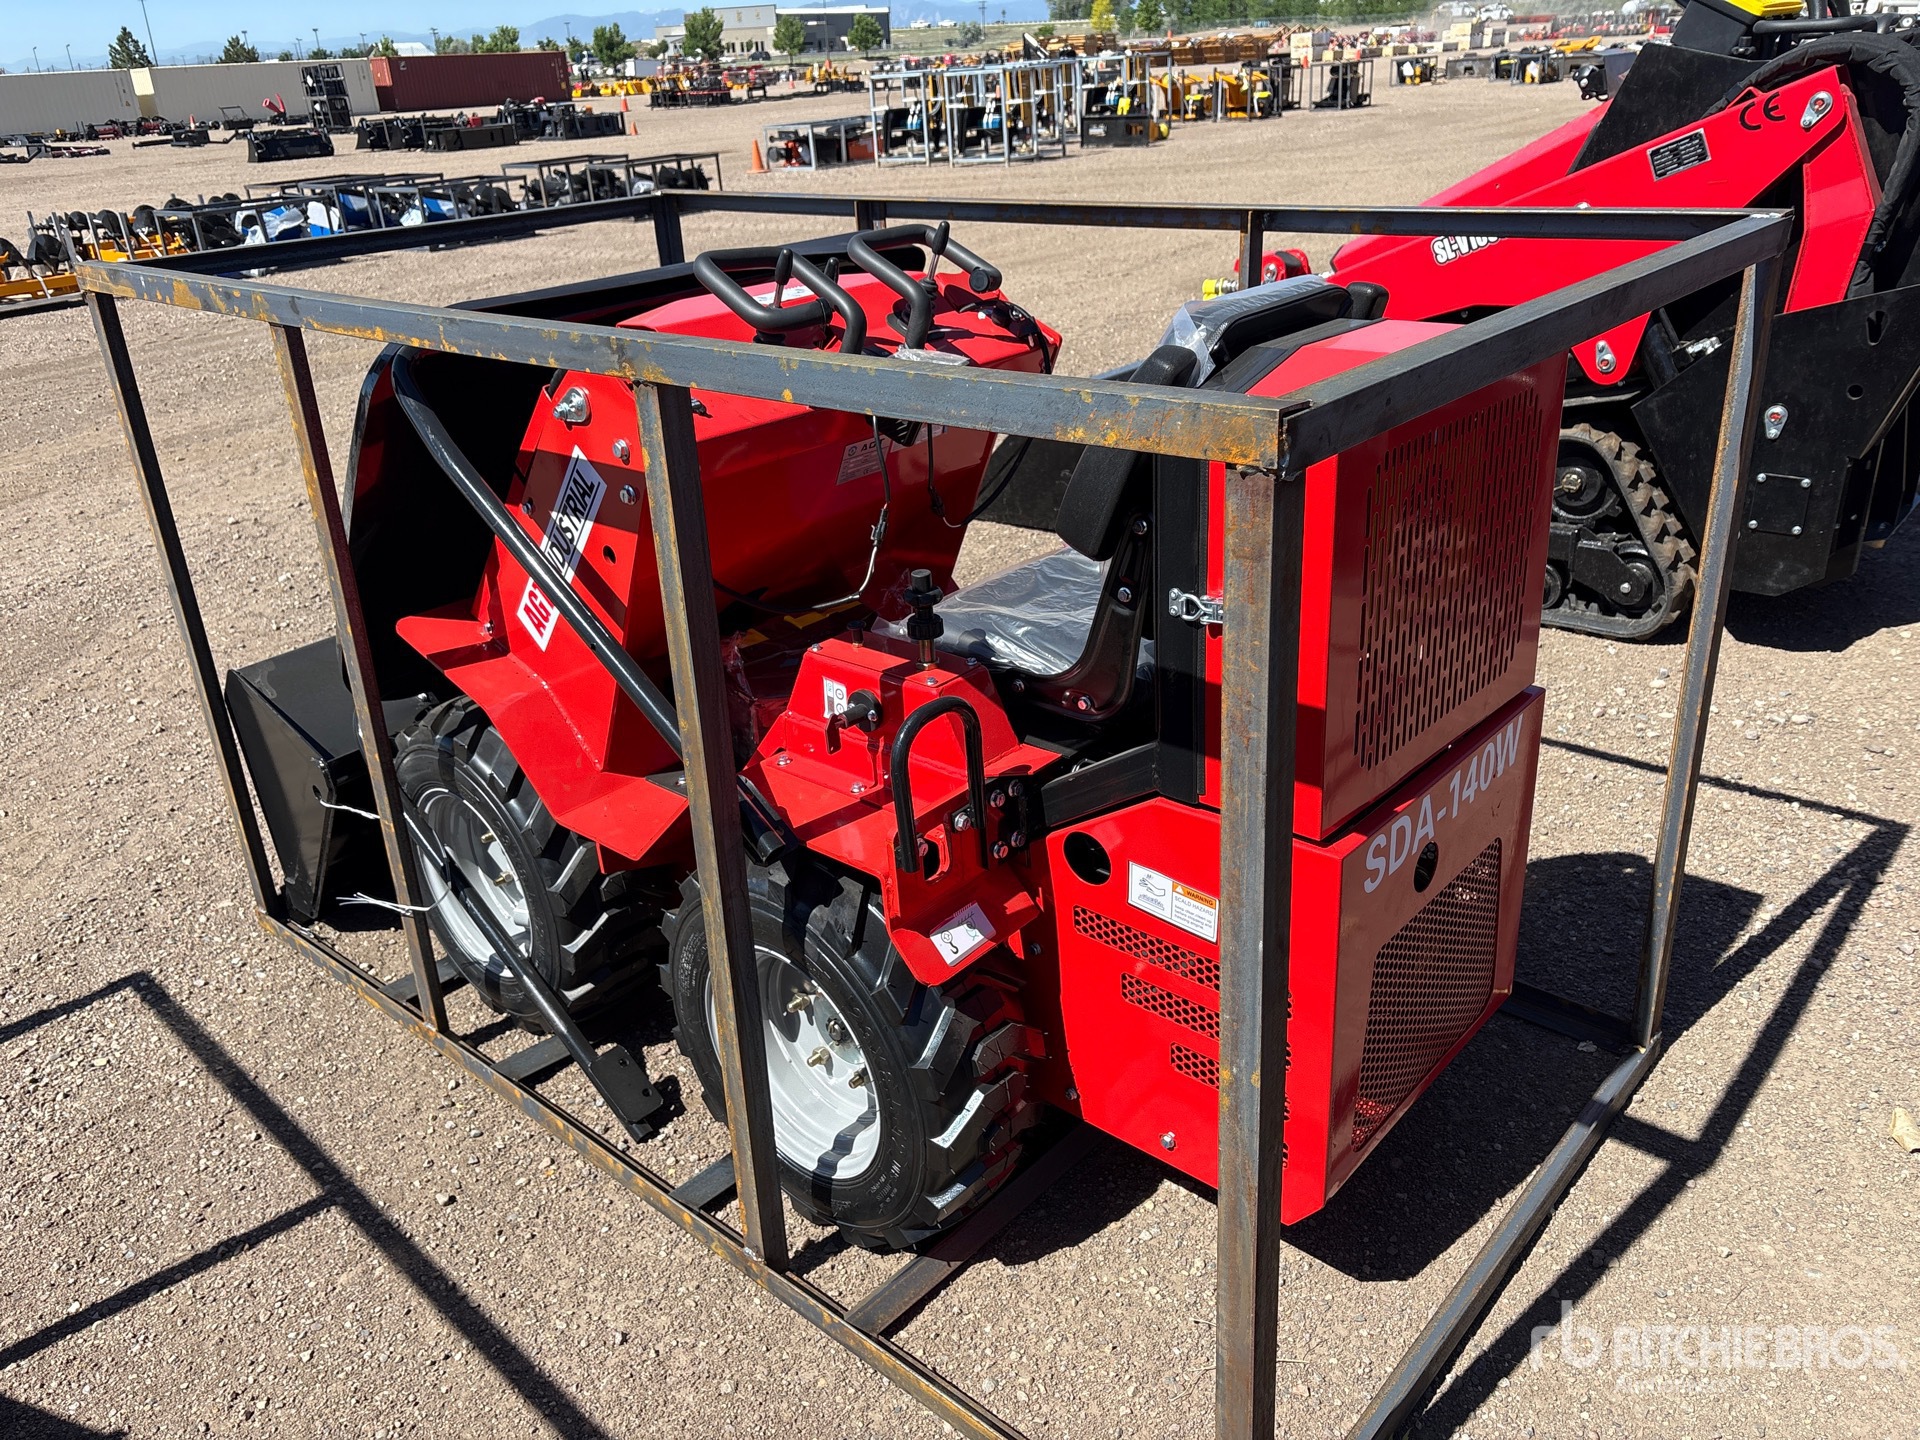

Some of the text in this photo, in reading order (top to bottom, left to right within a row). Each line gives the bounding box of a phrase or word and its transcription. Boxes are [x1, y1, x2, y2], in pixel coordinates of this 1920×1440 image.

[1740, 91, 1786, 130] CE
[1433, 235, 1499, 264] SL-V1
[547, 469, 596, 574] DUSTRIAL
[1363, 714, 1523, 894] SDA-140W
[1175, 895, 1213, 917] SCALD HAZARD
[1187, 890, 1213, 906] WARNING
